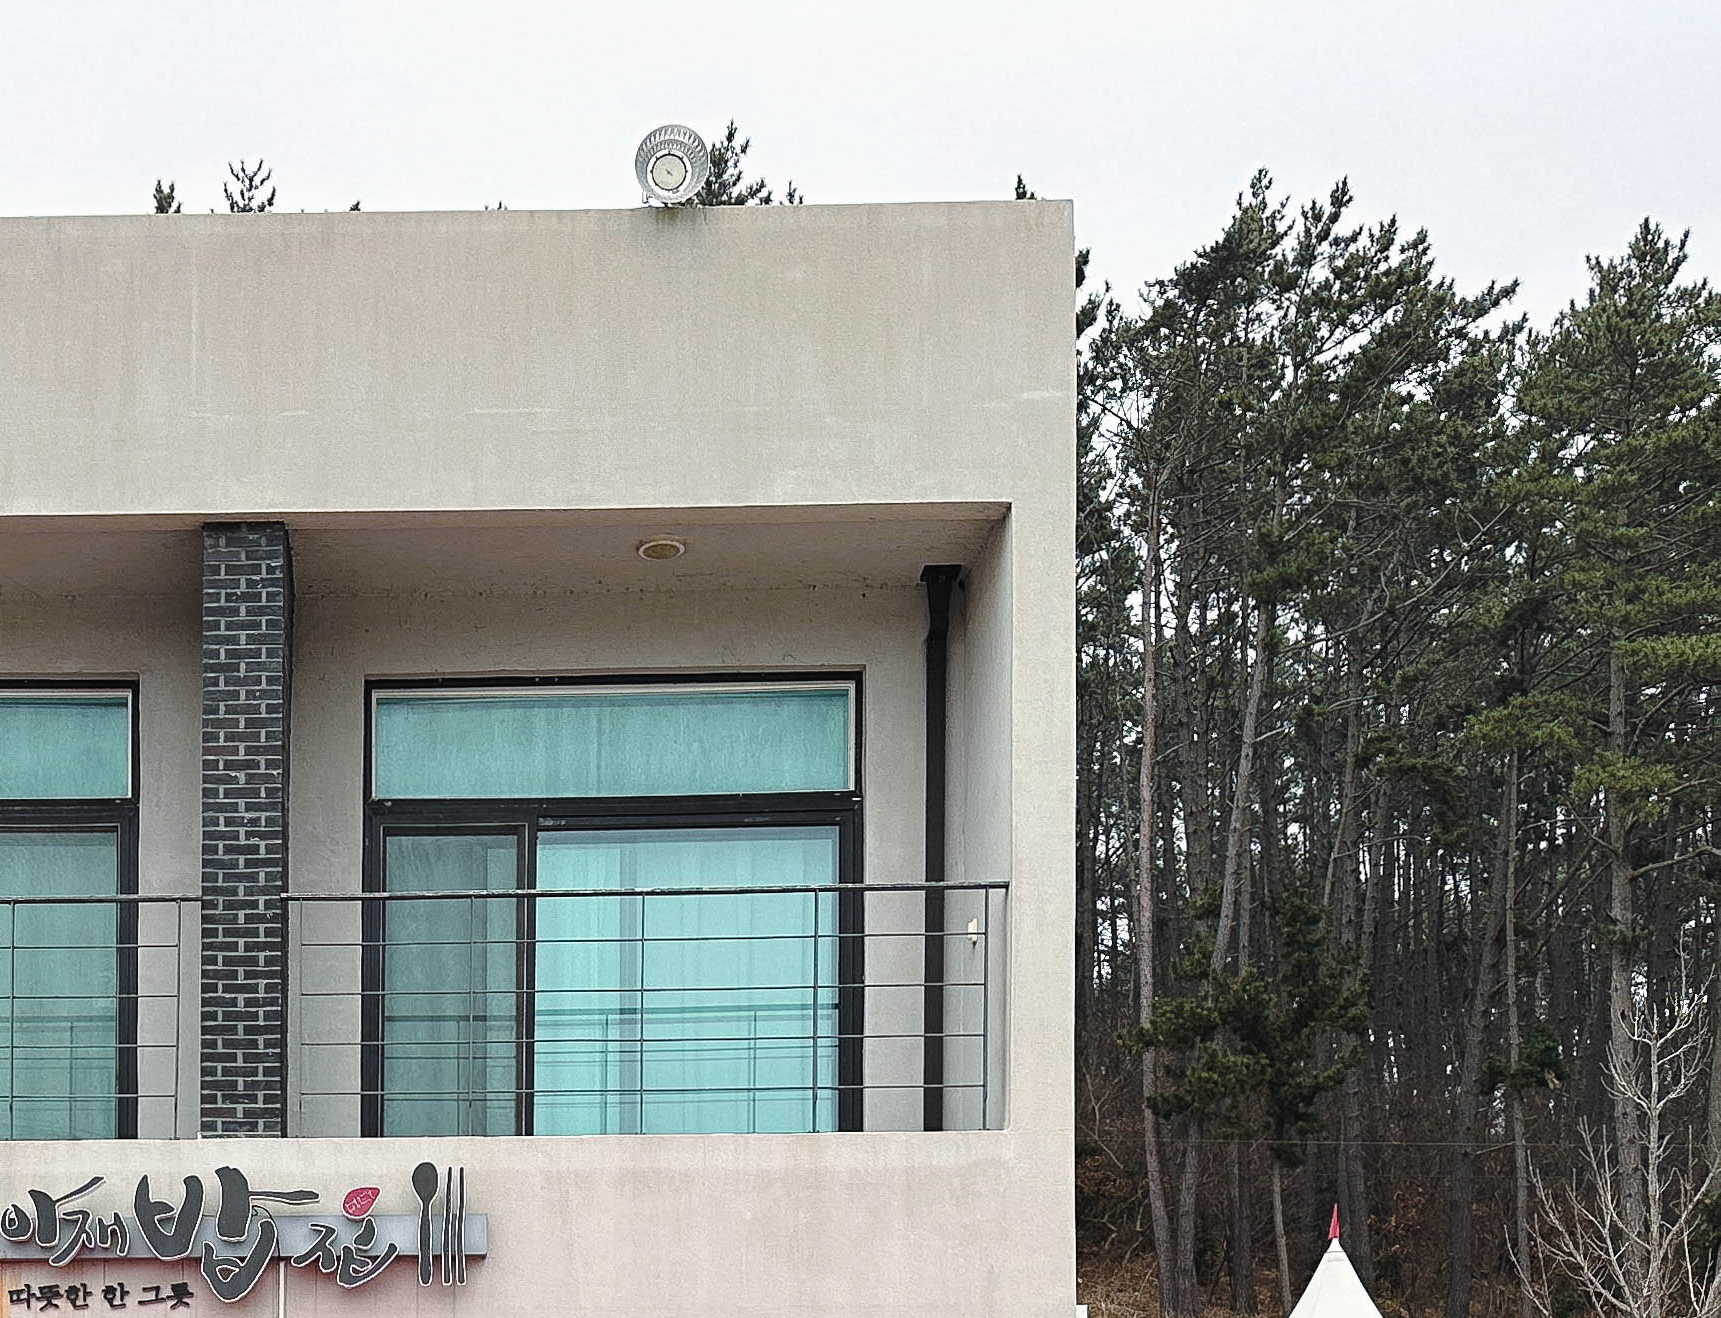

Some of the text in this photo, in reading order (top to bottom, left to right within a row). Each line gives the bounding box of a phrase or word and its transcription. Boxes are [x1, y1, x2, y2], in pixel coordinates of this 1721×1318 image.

[8, 1281, 195, 1311] 따뜻한 한 그릇
